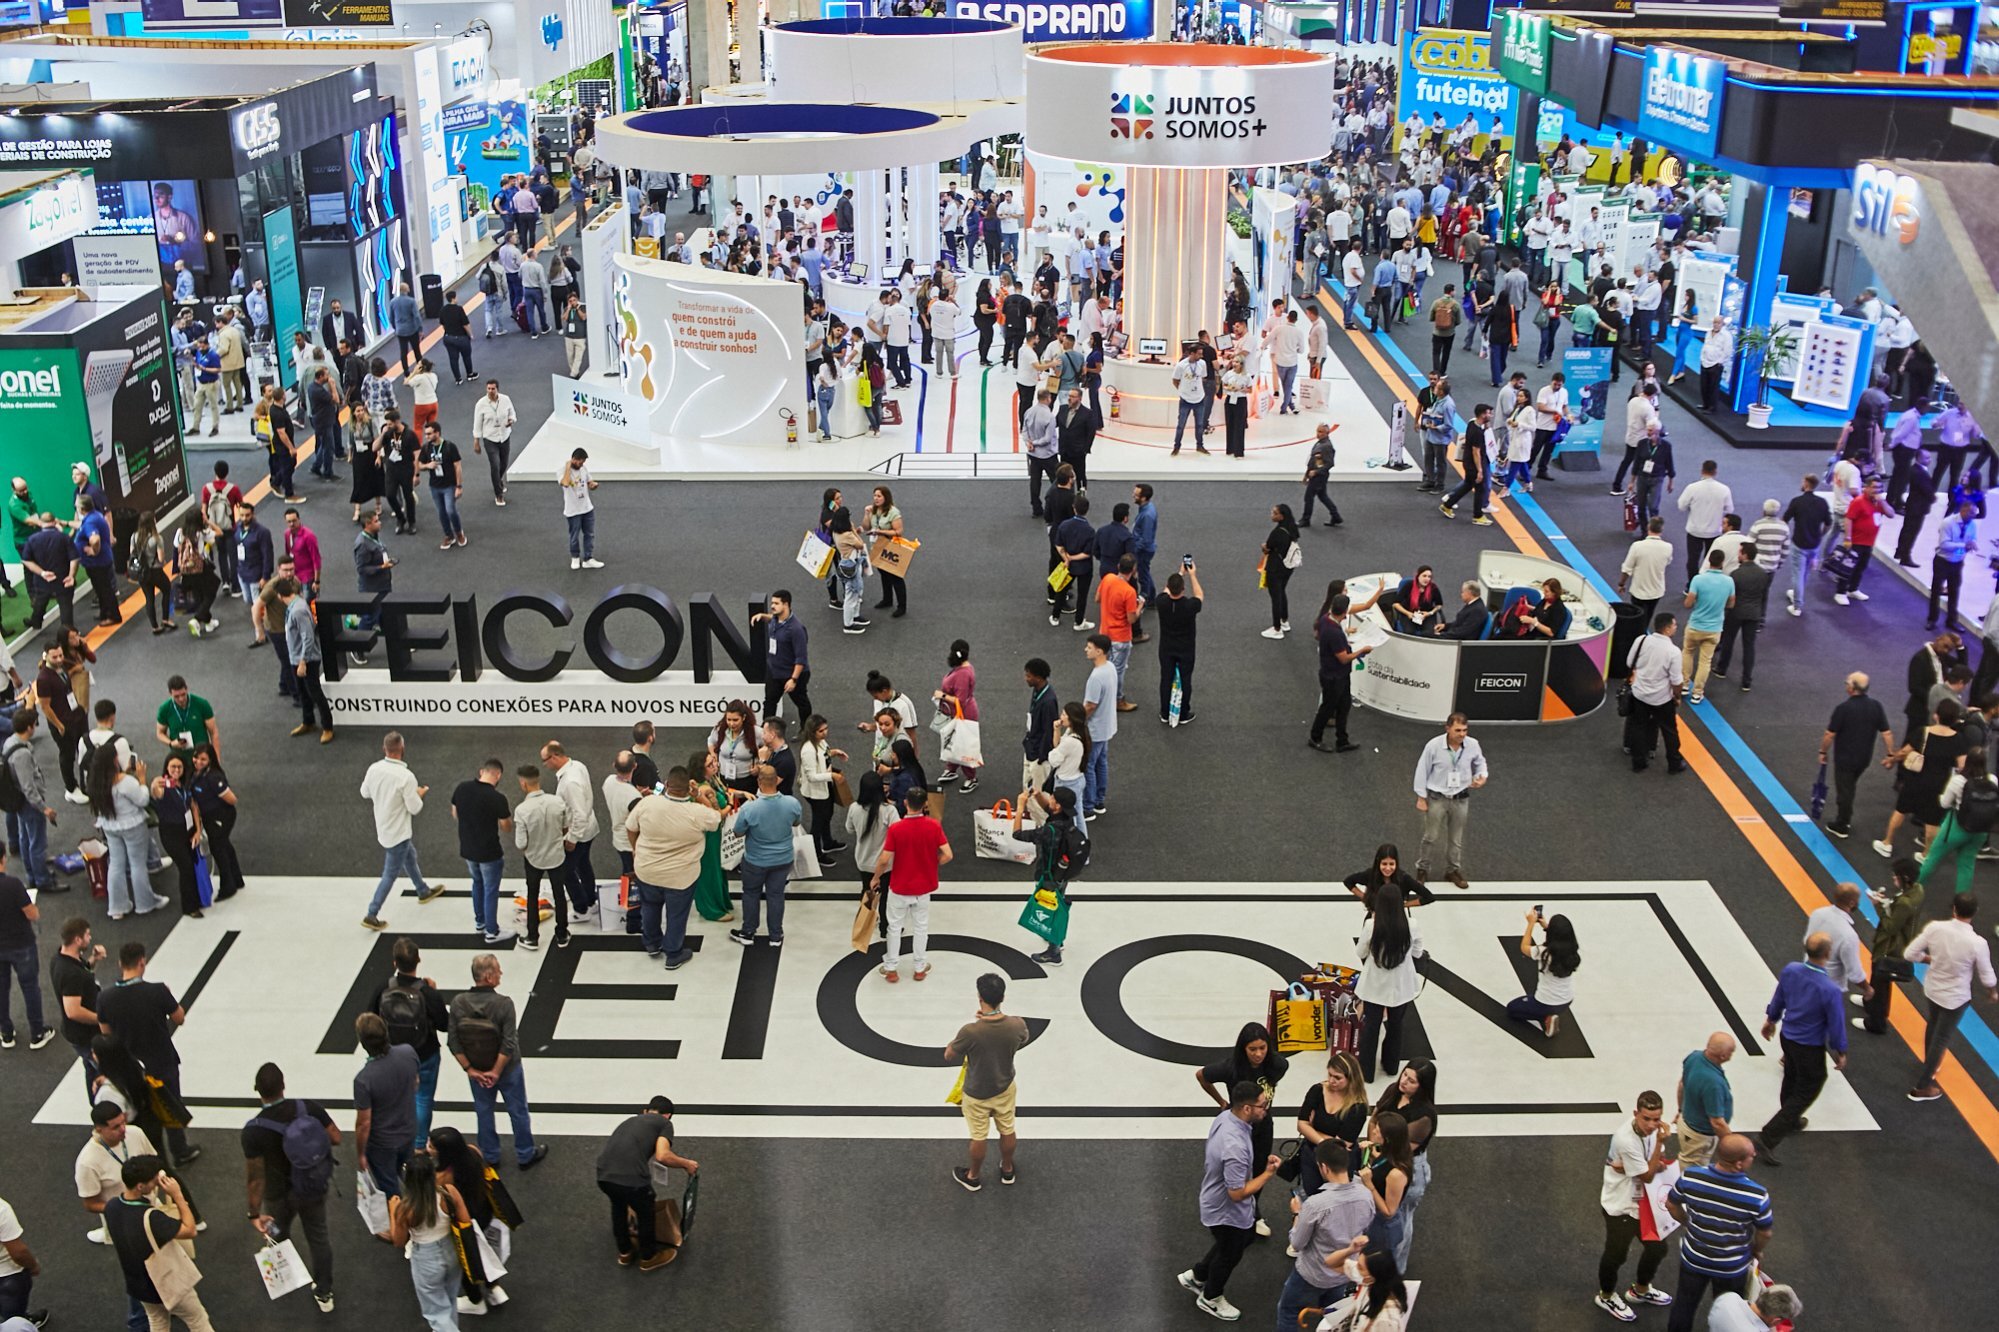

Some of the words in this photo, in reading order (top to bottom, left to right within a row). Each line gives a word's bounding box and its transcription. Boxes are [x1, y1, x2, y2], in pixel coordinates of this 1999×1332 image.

[342, 6, 389, 14] FERRAMENTAS
[359, 14, 389, 22] MANUAIS
[984, 3, 1126, 34] SOPRANO
[1422, 36, 1491, 70] cob
[1416, 78, 1509, 113] futebol
[1648, 67, 1713, 118] Eletromar
[446, 108, 465, 117] PILHA
[466, 104, 479, 113] QUE
[1165, 96, 1256, 115] JUNTOS
[464, 112, 485, 122] MAIS
[1166, 119, 1267, 139] SOMOS+
[2, 141, 16, 151] DE
[18, 139, 54, 151] GESTÃO
[57, 140, 82, 150] PARA
[83, 139, 112, 150] LOJAS
[32, 151, 46, 160] DE
[46, 149, 111, 160] CONSTRUÇÃO
[678, 301, 719, 313] Transformar
[728, 306, 743, 314] vida
[672, 313, 694, 324] quem
[697, 316, 736, 326] constrói
[680, 327, 685, 335] e
[687, 326, 697, 336] de
[700, 329, 726, 340] quem
[728, 330, 757, 342] ajuda
[680, 340, 717, 351] construir
[720, 343, 757, 353] sonhos!
[0, 364, 61, 394] onel
[592, 396, 623, 414] JUNTOS
[592, 409, 628, 427] SOMOS+
[317, 583, 768, 684] FEICON
[1368, 666, 1430, 689] Sustentabilidade
[1480, 678, 1521, 688] FEICON
[457, 695, 553, 714] CONEXÕES
[559, 699, 605, 713] PARA
[611, 699, 675, 714] NOVOS
[680, 695, 766, 715] NEGÓO
[316, 933, 1594, 1067] FEICON
[1311, 1005, 1322, 1040] vonder
